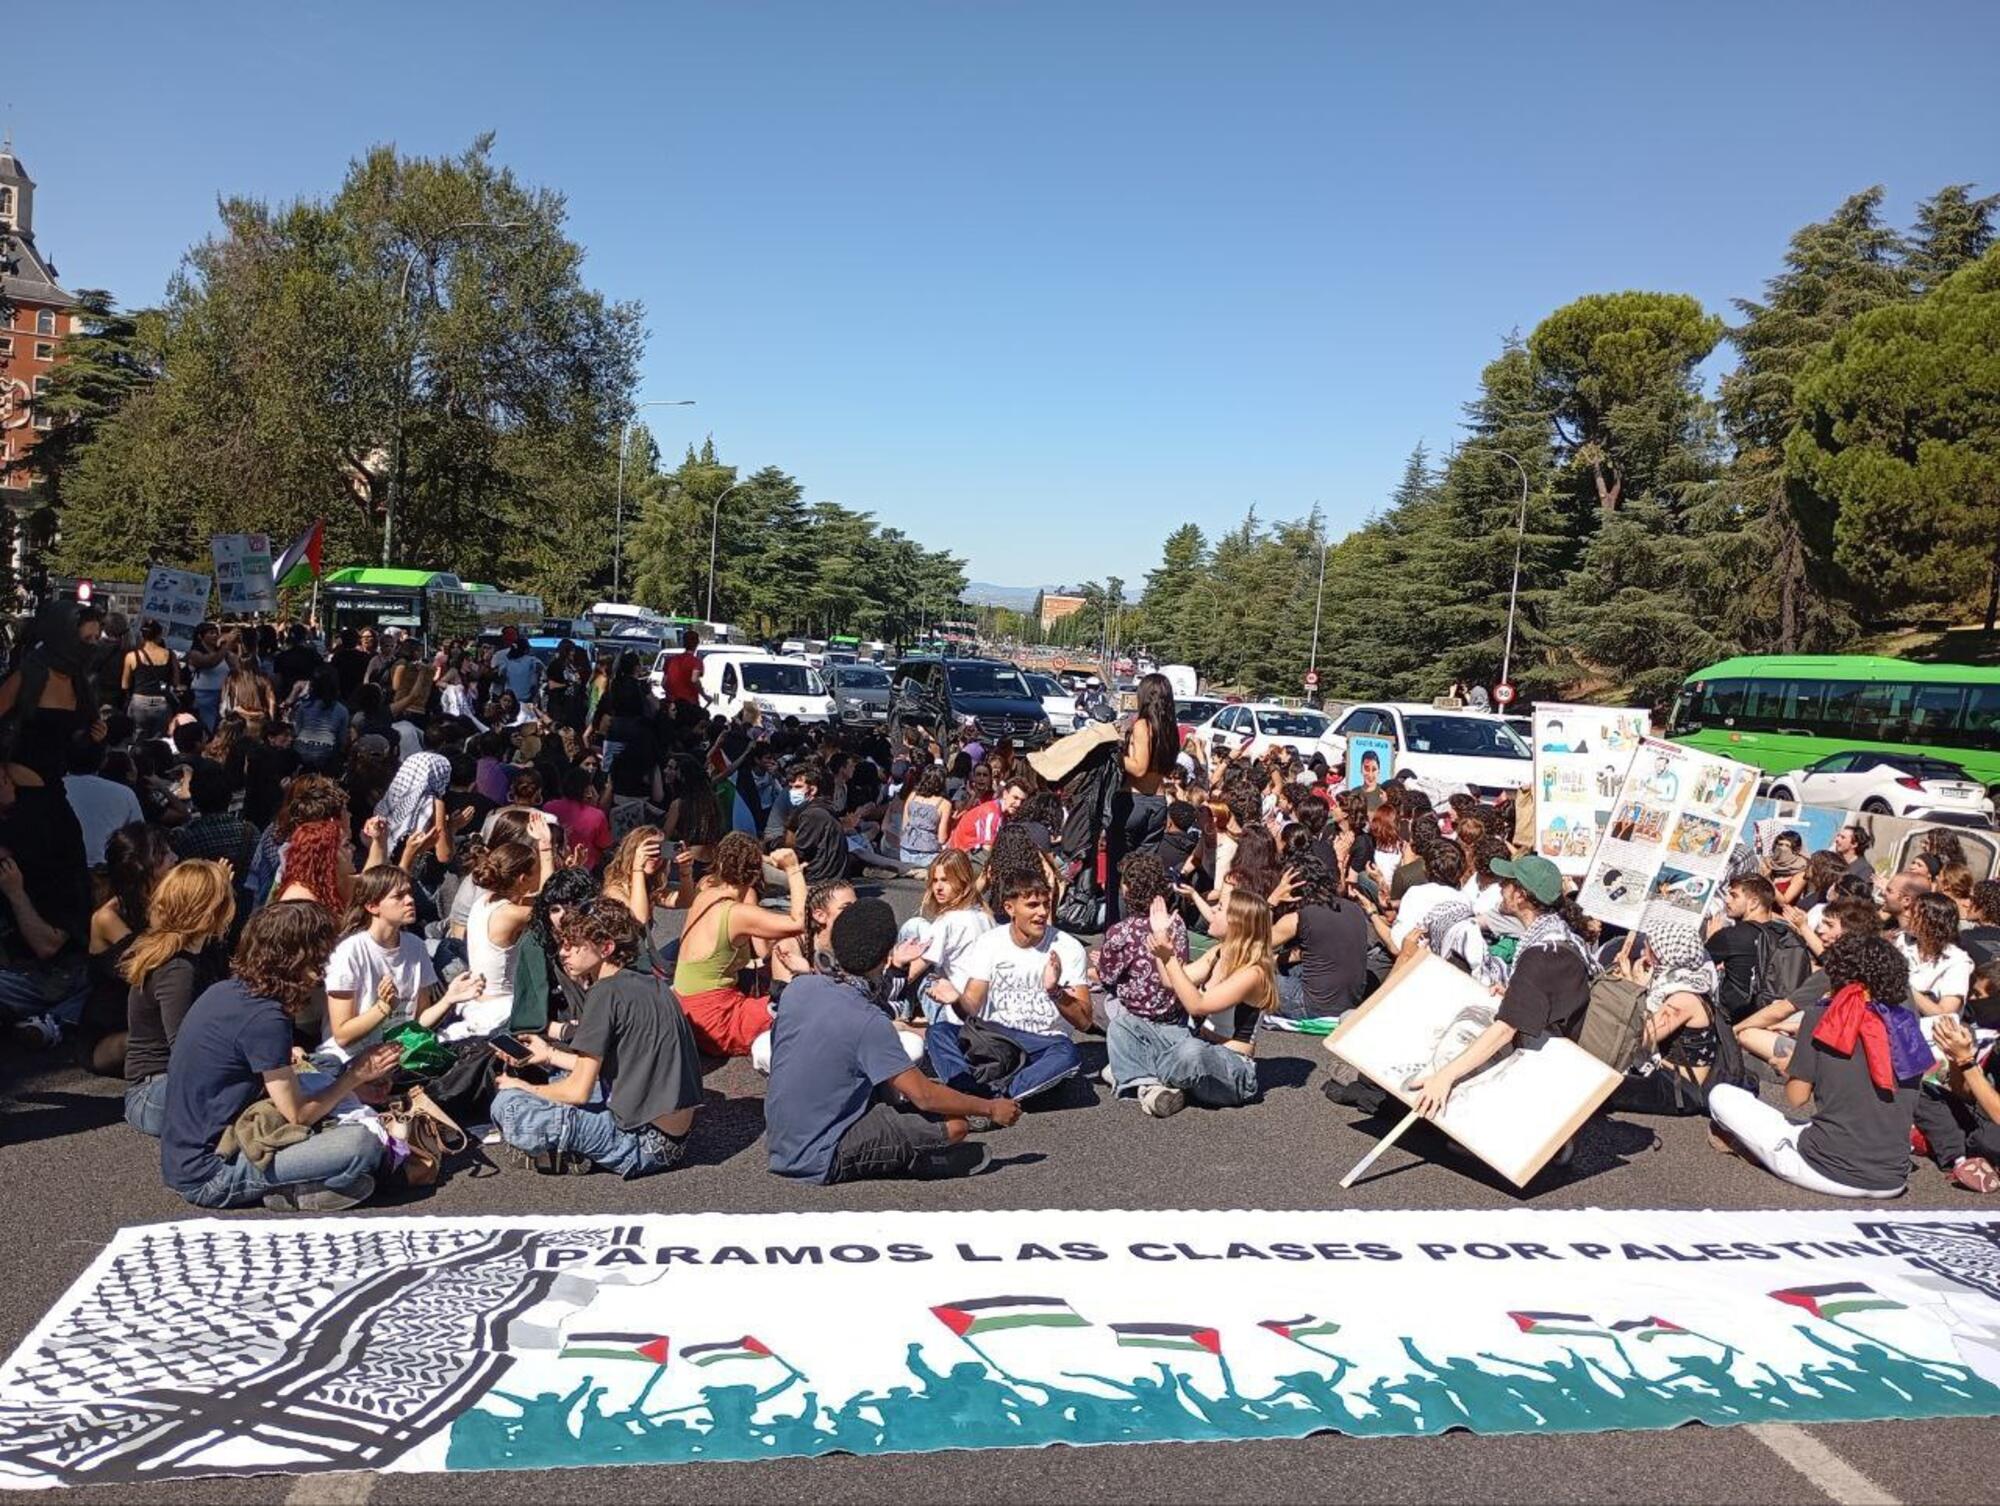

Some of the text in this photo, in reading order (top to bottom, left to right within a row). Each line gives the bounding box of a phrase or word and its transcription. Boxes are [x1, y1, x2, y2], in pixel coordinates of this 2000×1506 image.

[545, 1241, 1930, 1268] PARAMOS LAS CLASES POR PALESTINA
